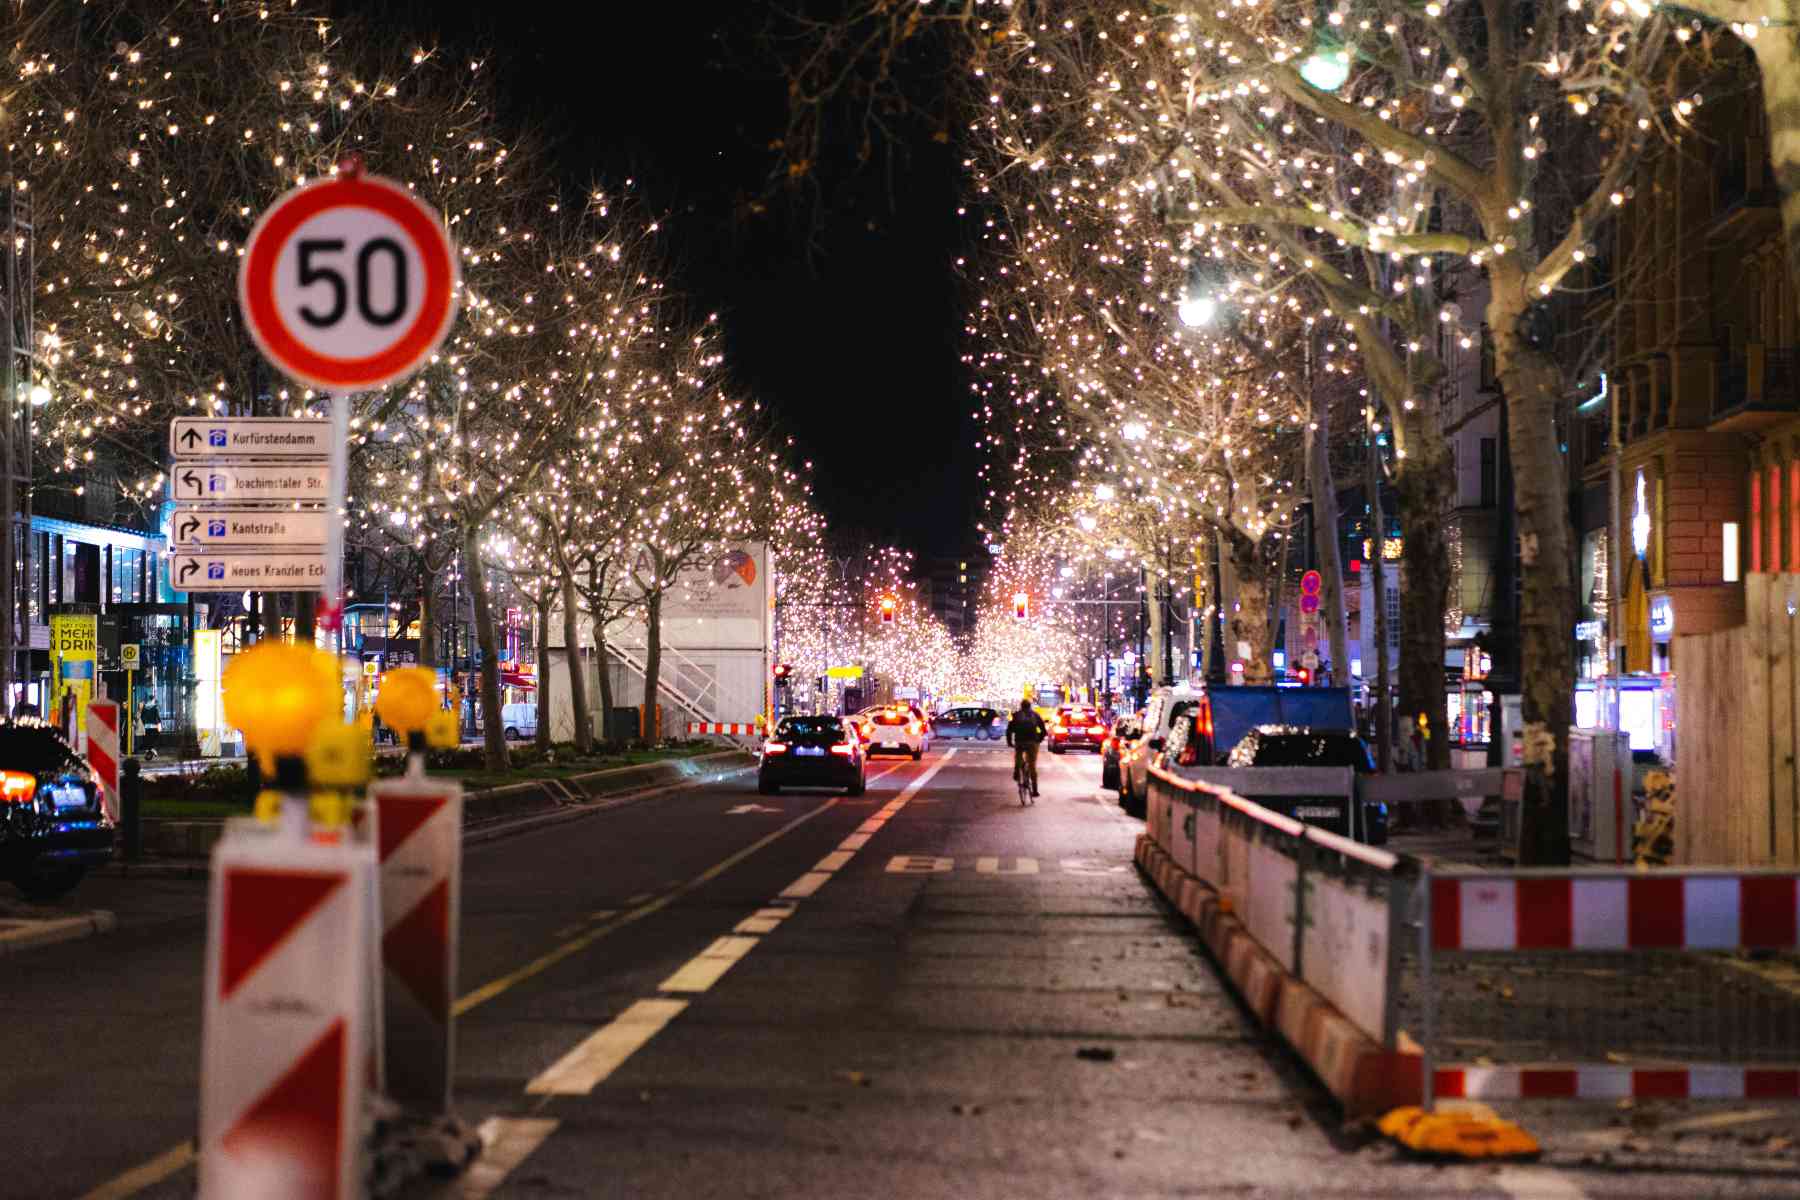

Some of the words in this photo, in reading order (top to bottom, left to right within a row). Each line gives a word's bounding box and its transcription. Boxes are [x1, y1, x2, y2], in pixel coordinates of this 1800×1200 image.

[297, 236, 409, 329] 50
[232, 432, 315, 445] Kurfürstendamm
[307, 477, 324, 489] Str.
[232, 522, 286, 535] Kantstraße
[231, 564, 261, 576] Neues
[264, 563, 304, 576] Kranzler
[309, 564, 327, 576] Eck
[60, 639, 96, 651] DRIN
